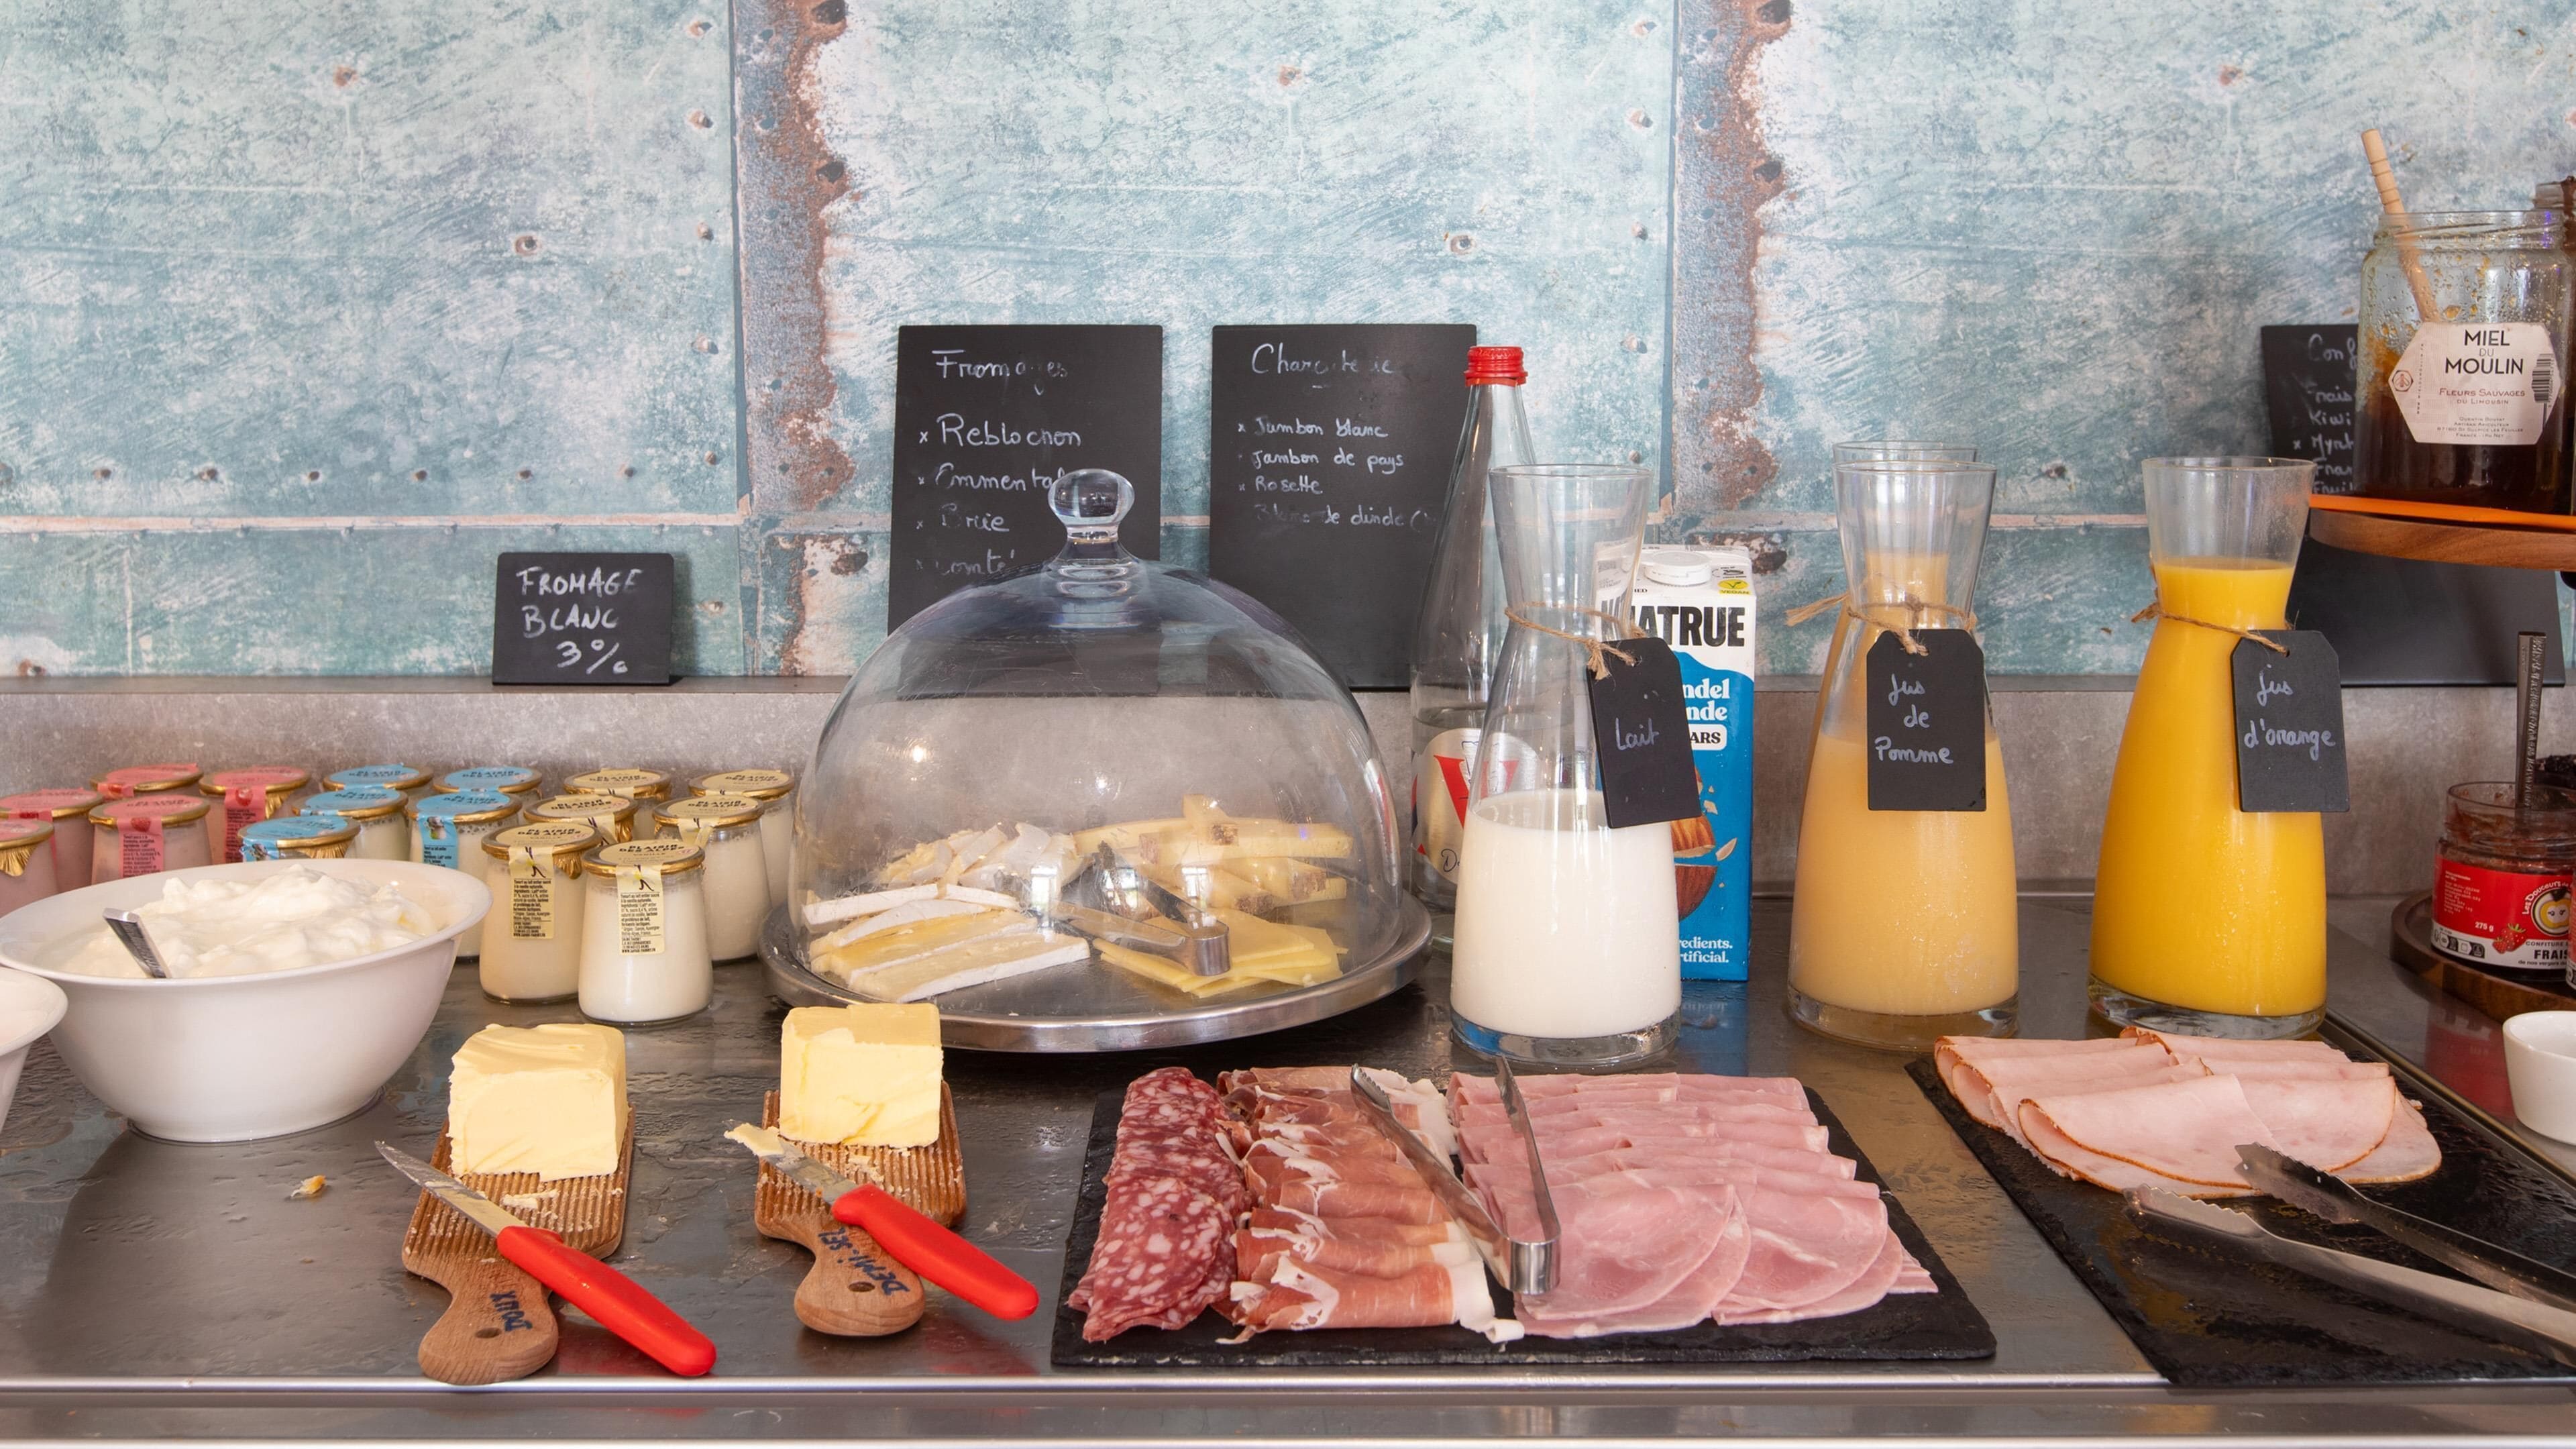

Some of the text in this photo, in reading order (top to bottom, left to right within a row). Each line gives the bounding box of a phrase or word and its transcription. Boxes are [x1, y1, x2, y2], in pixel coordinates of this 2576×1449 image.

[2464, 329, 2510, 346] MIEL
[2308, 333, 2357, 370] Conf
[2479, 348, 2494, 357] DU
[2445, 357, 2524, 374] MOULIN
[1336, 418, 1389, 437] blanc
[2308, 410, 2351, 425] Kiwi
[1252, 447, 1404, 474] Jambon de pays
[1254, 475, 1324, 494] Rosette
[515, 566, 643, 598] FROMAGE
[521, 603, 620, 639] BLANC
[1632, 605, 1745, 647] ATRUE
[1682, 678, 1730, 699] ndel
[1685, 700, 1727, 721] nde
[1903, 704, 1930, 728] de
[1690, 731, 1721, 744] ARS
[2244, 718, 2336, 761] d'orange
[1874, 736, 1954, 764] Pomme
[1679, 936, 1733, 949] edients.
[1680, 951, 1729, 963] tificial.
[2534, 949, 2568, 959] FRAIS
